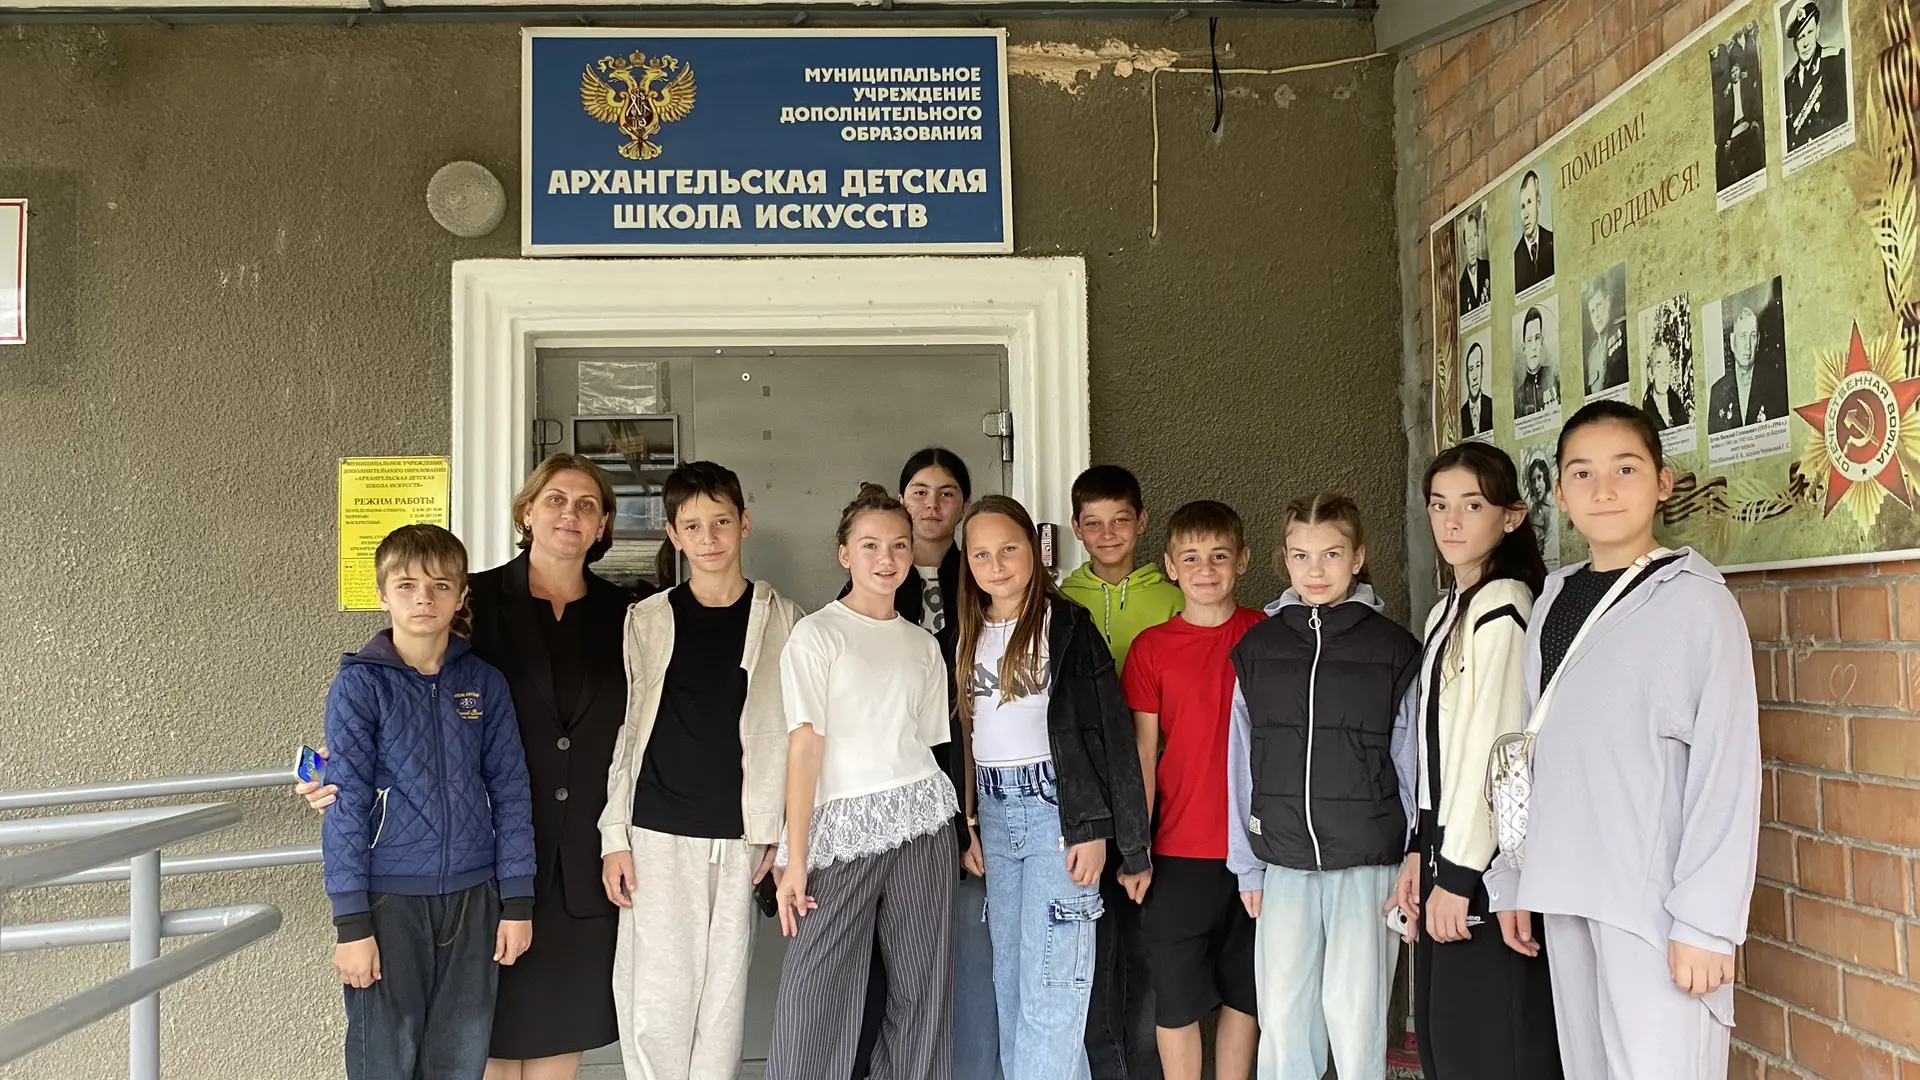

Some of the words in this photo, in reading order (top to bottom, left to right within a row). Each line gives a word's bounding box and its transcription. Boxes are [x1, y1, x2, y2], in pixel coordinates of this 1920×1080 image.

[804, 67, 981, 84] МУНИЦИПАЛЬНОЕ
[853, 86, 982, 104] УЧРЕЖДЕНИЕ
[780, 106, 982, 124] ДОПОЛНИТЕЛЬНОГО
[841, 125, 982, 142] ОБРАЗОВАНИЯ
[1560, 112, 1645, 190] ПОМНИМ!
[547, 169, 827, 195] АРХАНГЕЛЬСКАЯ
[841, 168, 987, 198] ДЕТСКАЯ
[1590, 161, 1700, 245] ГОРДИМСЯ!
[613, 203, 742, 230] ШКОЛА
[755, 203, 928, 229] ИСКУССТВ
[1828, 376, 1889, 473] ОТЕЧЕСТВЕННАЯ
[395, 497, 435, 505] РАБОТЫ
